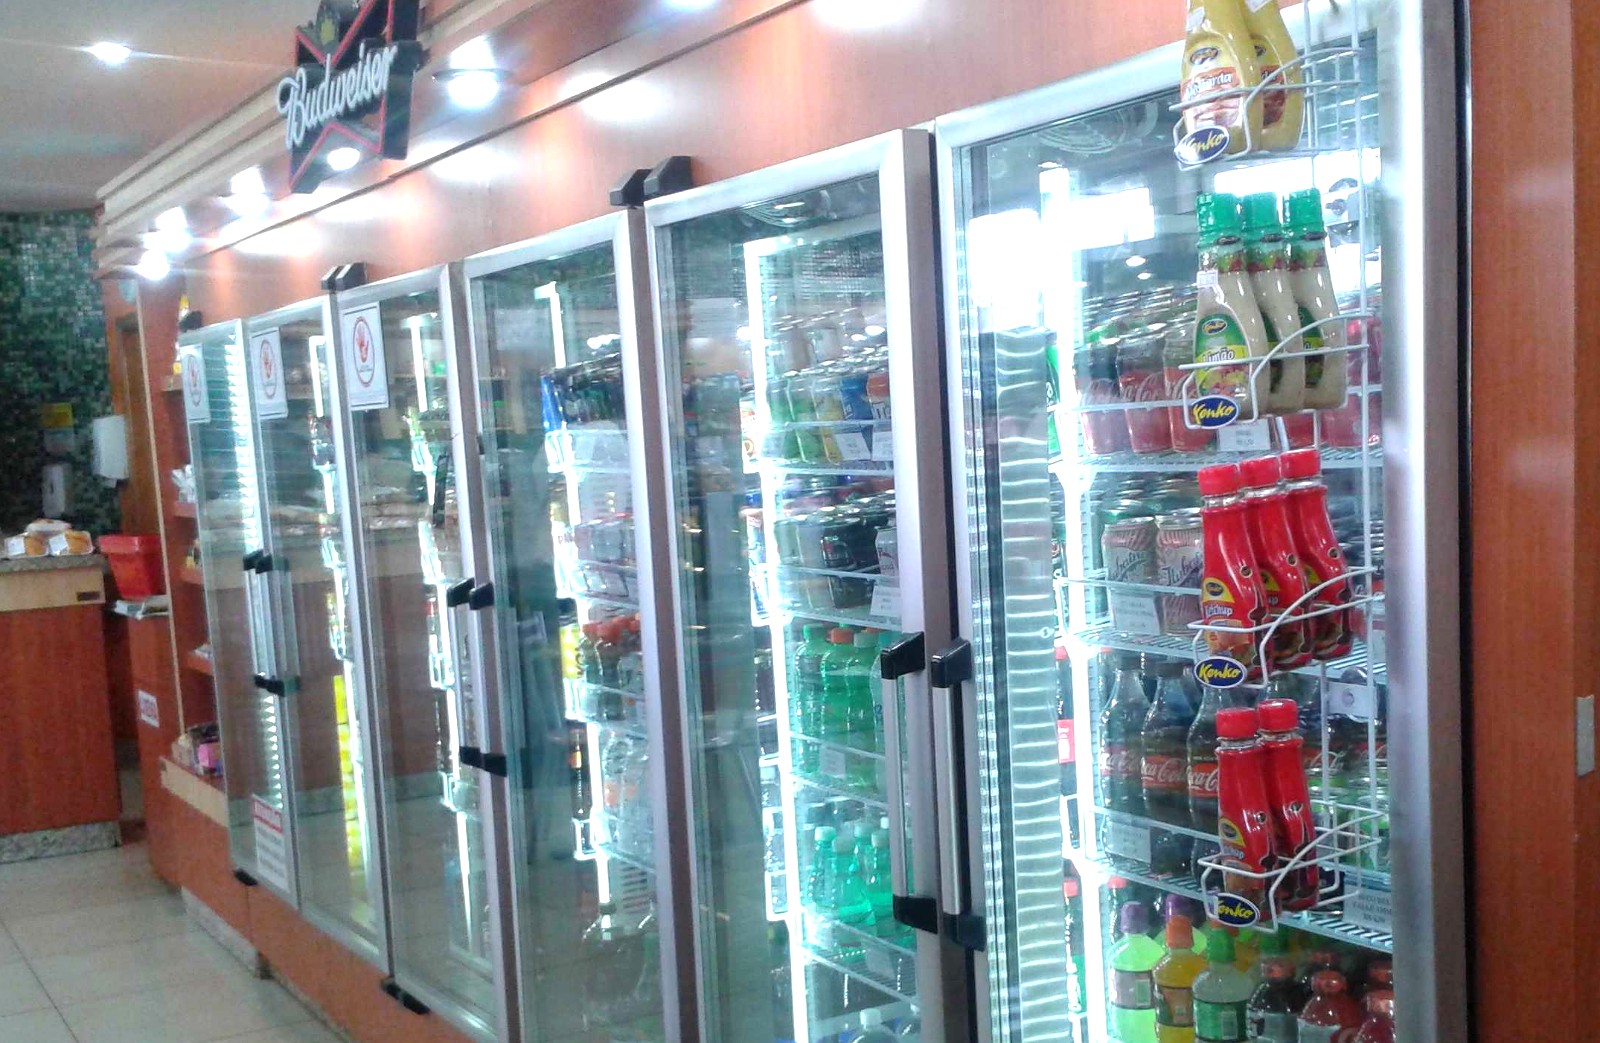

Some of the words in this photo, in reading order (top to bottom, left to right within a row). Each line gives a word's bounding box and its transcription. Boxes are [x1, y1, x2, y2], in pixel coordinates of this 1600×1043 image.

[277, 41, 398, 149] Budweiser
[1193, 401, 1235, 424] Kenko
[1199, 663, 1241, 684] Kenko
